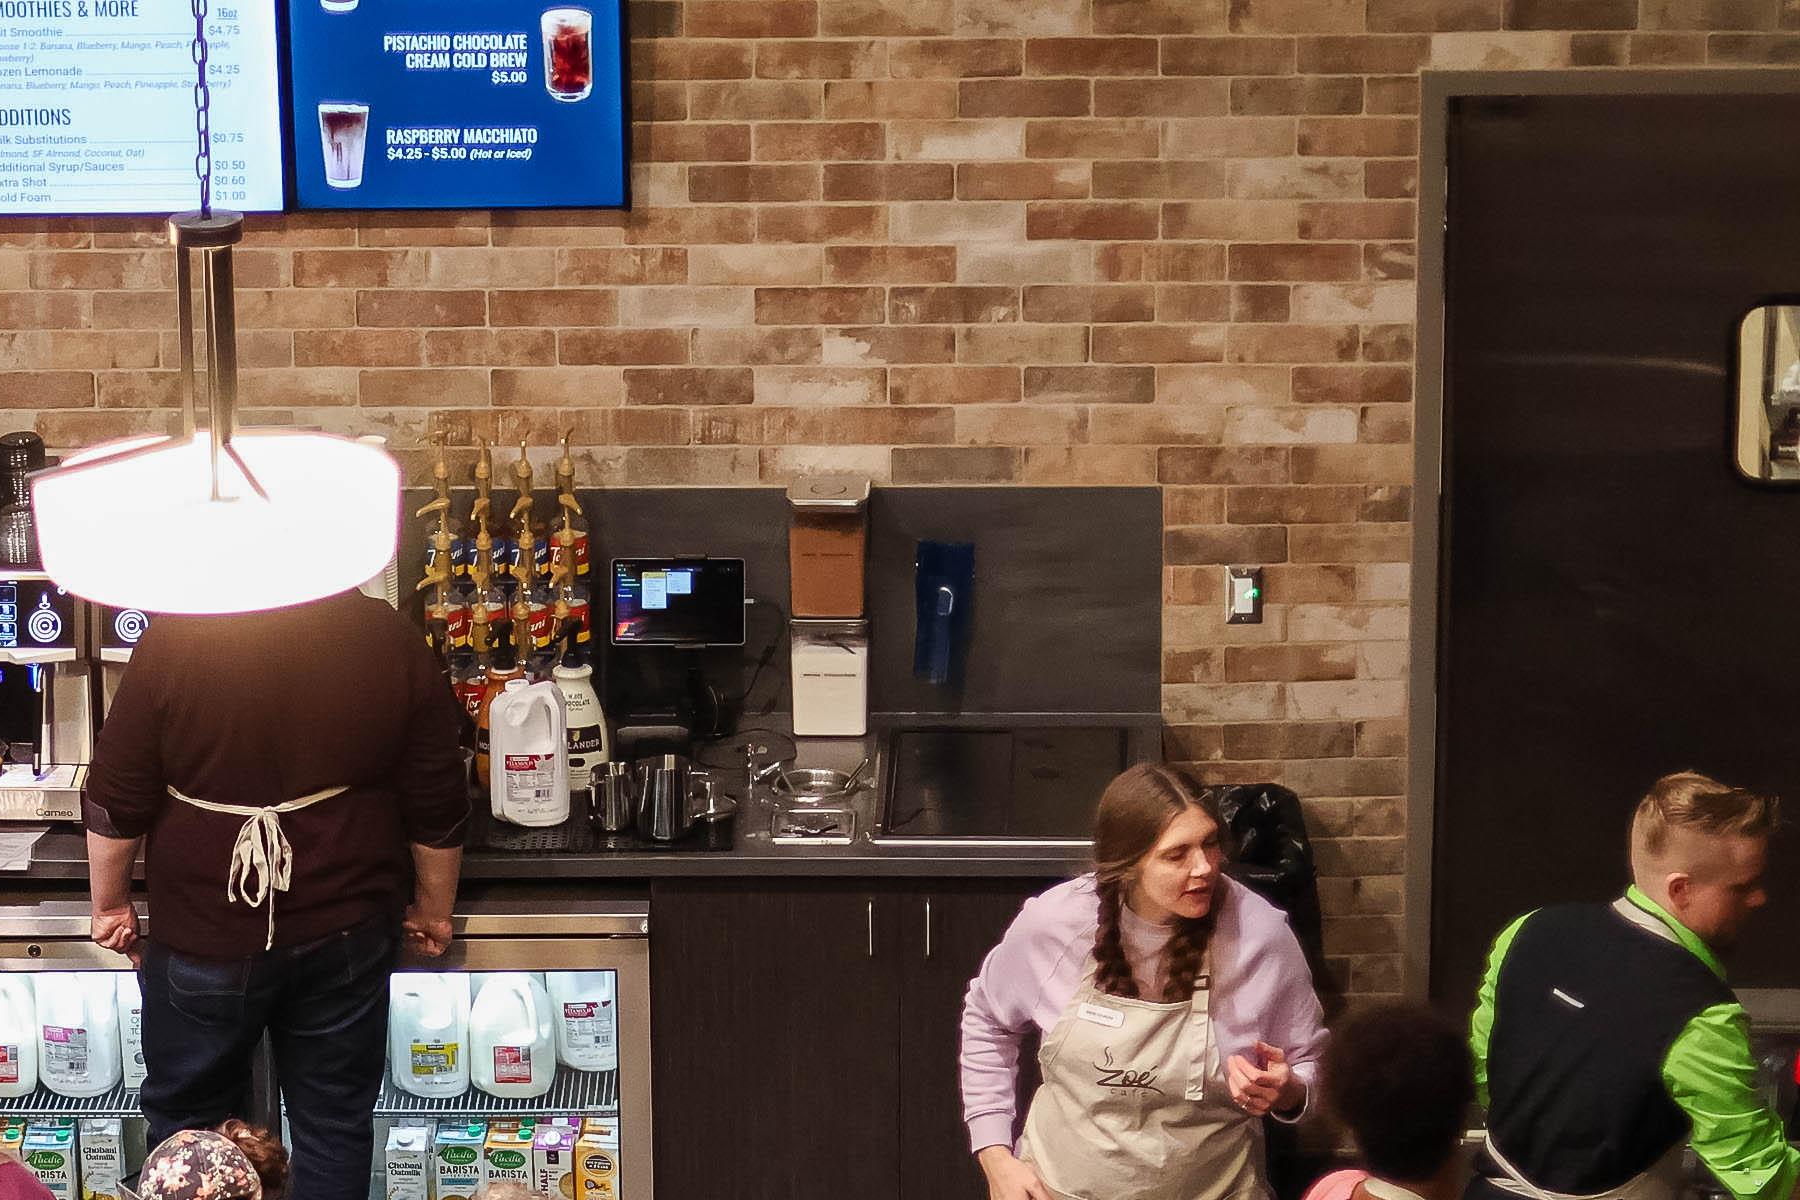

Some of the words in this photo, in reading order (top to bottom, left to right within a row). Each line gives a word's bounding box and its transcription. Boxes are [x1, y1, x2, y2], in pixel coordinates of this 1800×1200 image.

[78, 1, 89, 17] &
[95, 1, 139, 17] MORE
[10, 26, 63, 37] Smoothie
[208, 25, 241, 36] $4.75
[383, 34, 450, 51] PISTACHIO
[453, 34, 528, 50] CHOCOLATE
[405, 53, 450, 69] CREAM
[452, 53, 487, 69] COLD
[490, 52, 528, 68] BREW
[25, 65, 82, 76] Lemonade
[209, 64, 240, 75] $4.25
[491, 71, 527, 84] $5.00
[14, 134, 88, 145] Substitutions
[212, 132, 244, 143] $0.75
[386, 128, 460, 145] RASPBERRY
[463, 128, 538, 144] MACCHIATO
[387, 147, 423, 160] $4.25
[431, 147, 467, 160] $5.00
[469, 148, 491, 161] (Hot
[493, 151, 504, 160] or
[506, 148, 532, 161] Iced)
[48, 161, 125, 173] Syrup/Sauces
[214, 160, 246, 170] $0.50
[22, 177, 47, 187] Shot
[20, 192, 52, 202] Foam
[215, 190, 246, 201] $1.00
[35, 807, 74, 817] Cameo
[446, 1147, 475, 1159] Pacific
[494, 1152, 522, 1163] Pacific
[31, 1153, 62, 1166] Pacific
[388, 1161, 422, 1169] Chobani
[439, 1166, 480, 1174] BARISTA
[488, 1170, 528, 1179] BARISTA
[540, 1168, 549, 1191] HALF
